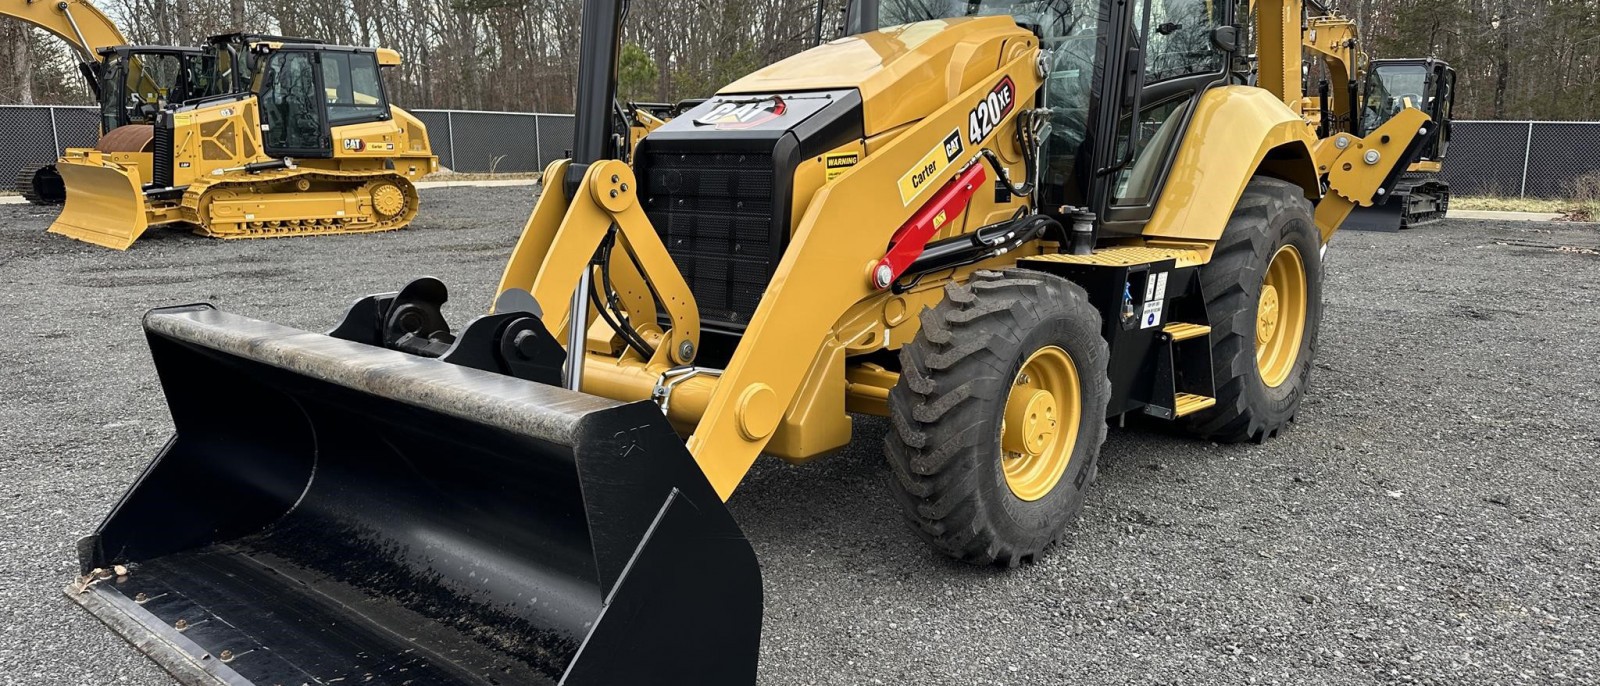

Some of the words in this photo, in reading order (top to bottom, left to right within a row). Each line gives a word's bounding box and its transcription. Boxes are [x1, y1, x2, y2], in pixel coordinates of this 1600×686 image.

[698, 99, 776, 123] CAT
[344, 138, 361, 150] CAT
[945, 135, 960, 158] CAT
[828, 157, 857, 167] WARNING
[911, 159, 937, 189] Carter
